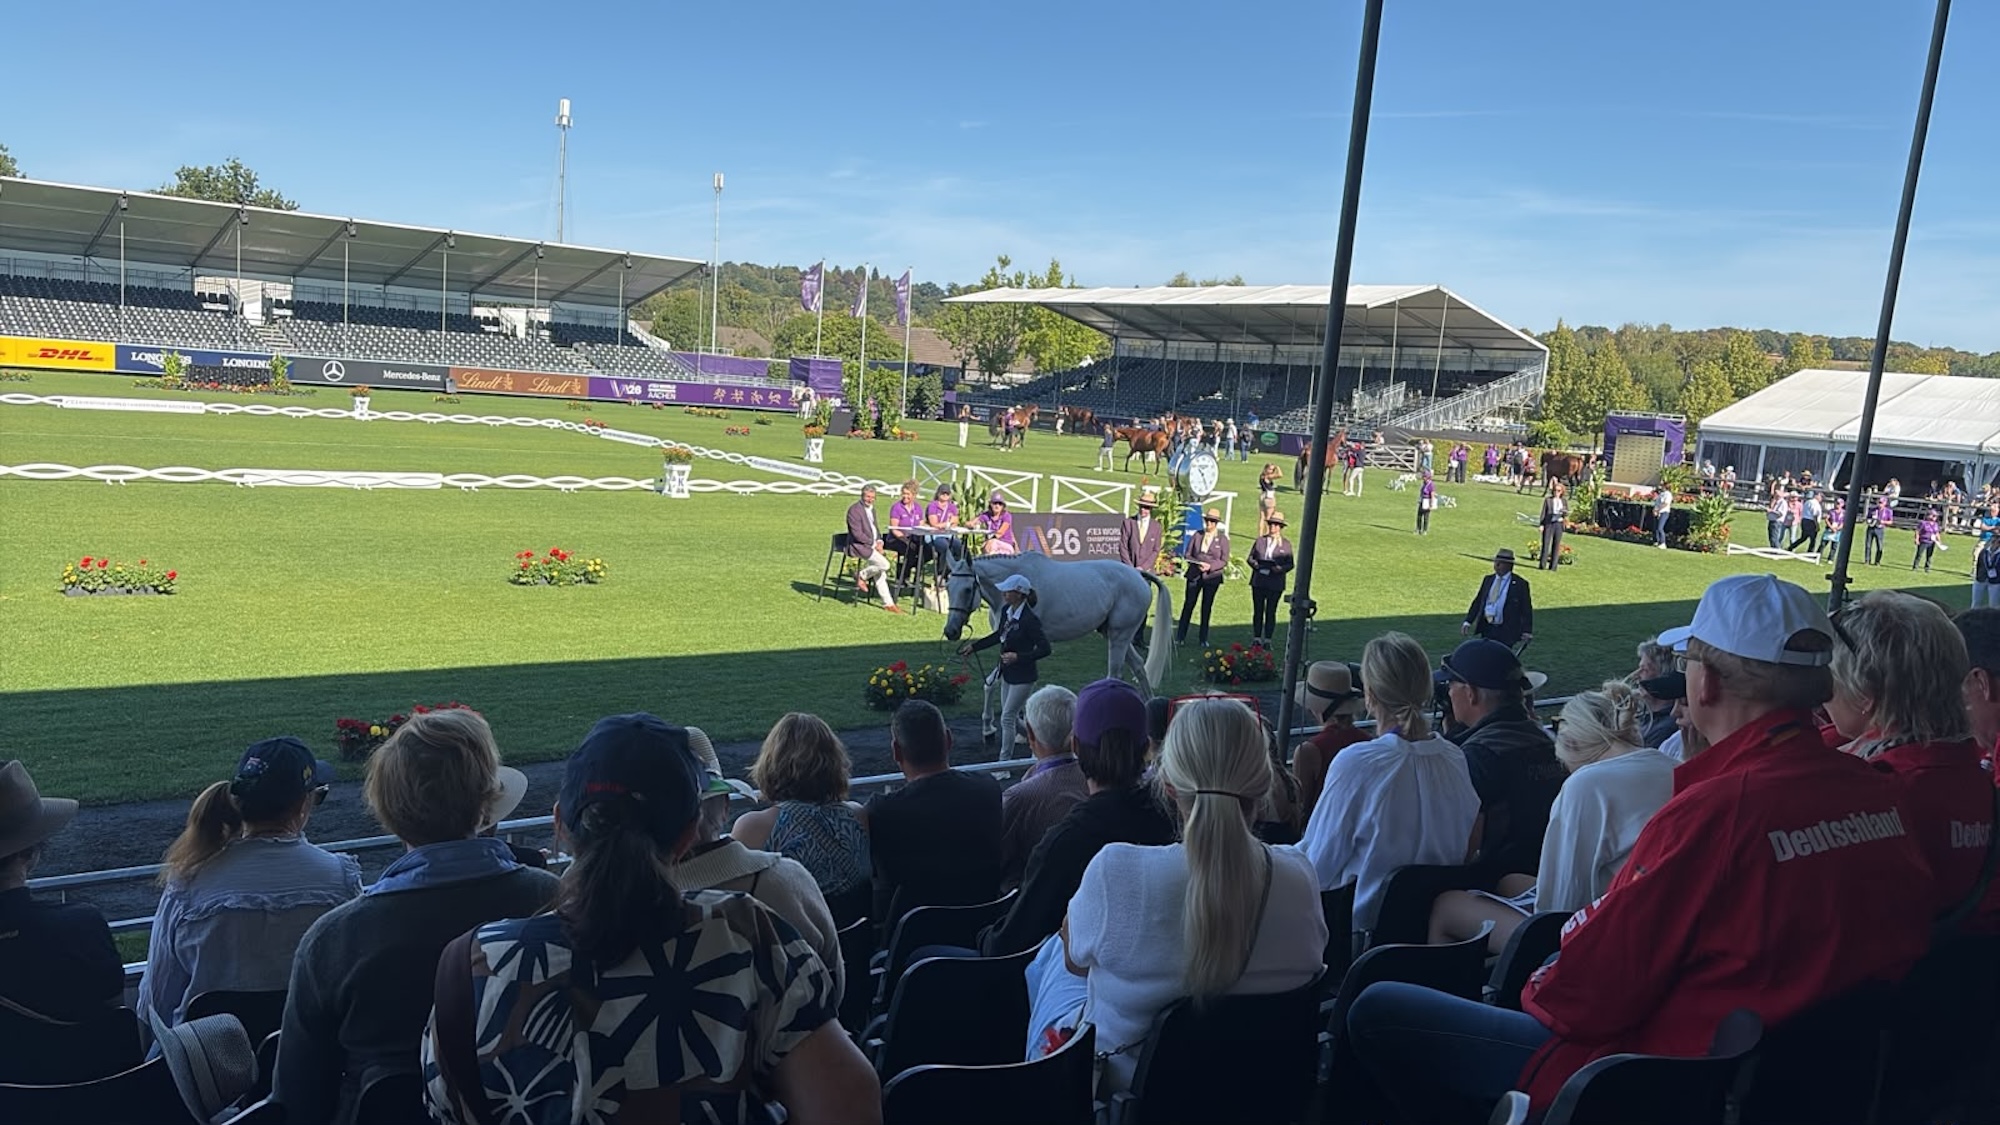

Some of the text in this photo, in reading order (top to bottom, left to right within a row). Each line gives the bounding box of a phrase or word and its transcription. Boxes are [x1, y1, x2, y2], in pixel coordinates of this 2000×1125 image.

[39, 348, 93, 361] DHL
[131, 351, 192, 365] LONGES
[383, 369, 441, 381] Mercedes-Benz
[458, 371, 502, 389] Lindt
[528, 376, 571, 393] Lindt
[1088, 543, 1121, 555] AACHE
[1768, 806, 1907, 863] Deutschland
